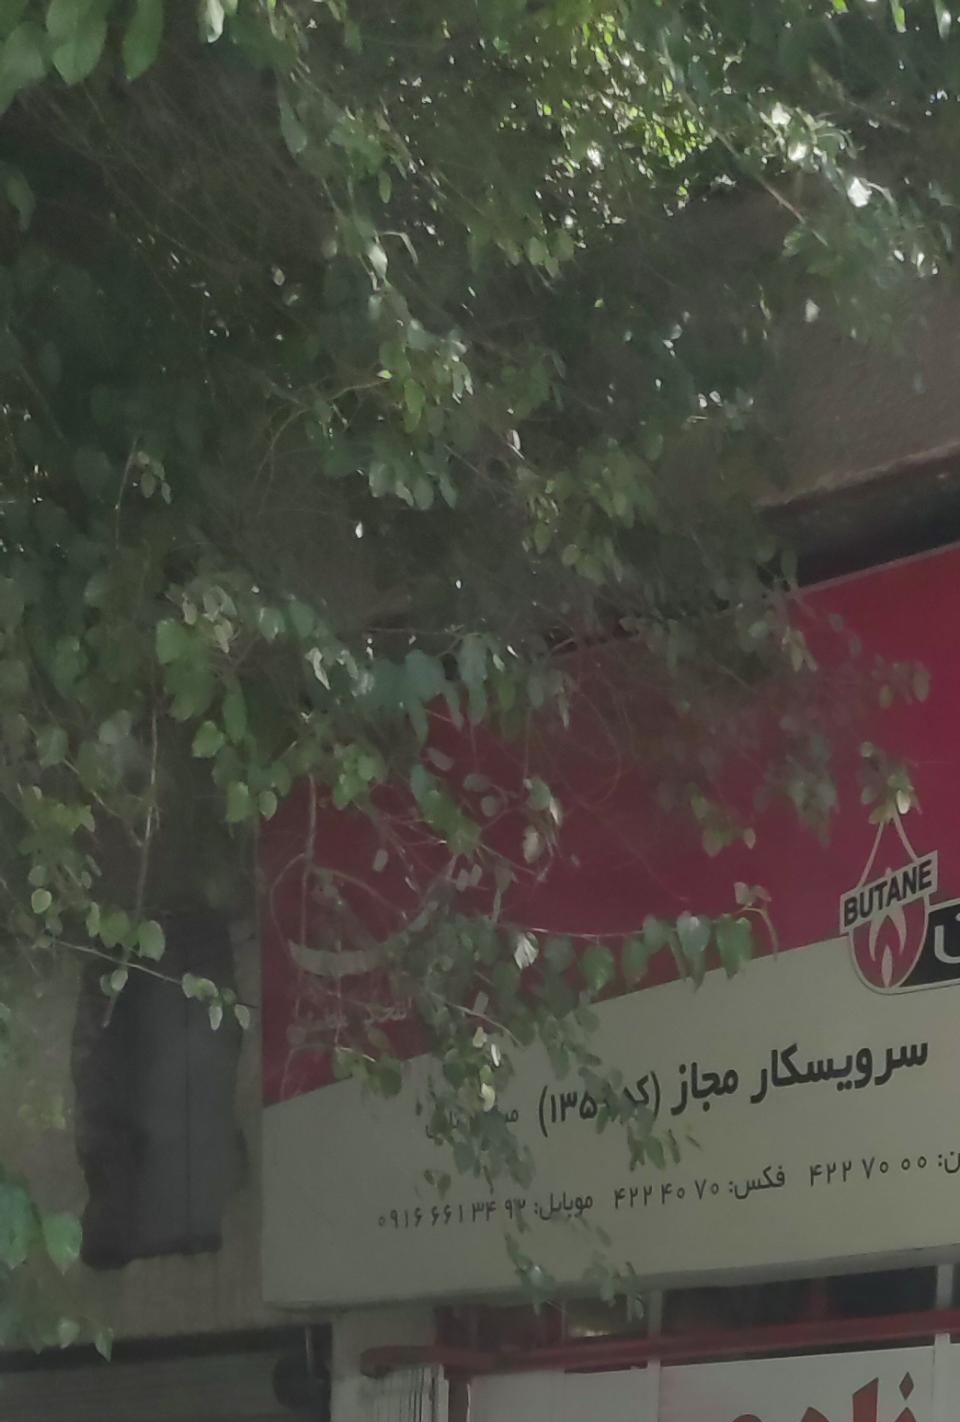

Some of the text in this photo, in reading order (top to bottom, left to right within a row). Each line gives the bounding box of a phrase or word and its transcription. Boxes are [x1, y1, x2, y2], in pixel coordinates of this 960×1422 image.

[843, 858, 932, 928] BUTANE
[670, 1061, 739, 1116] مجاز
[750, 1042, 929, 1104] سرویسکار
[727, 1164, 786, 1200] فکس:
[808, 1162, 852, 1187] ۴۲۲
[534, 1191, 594, 1221] موبایل:
